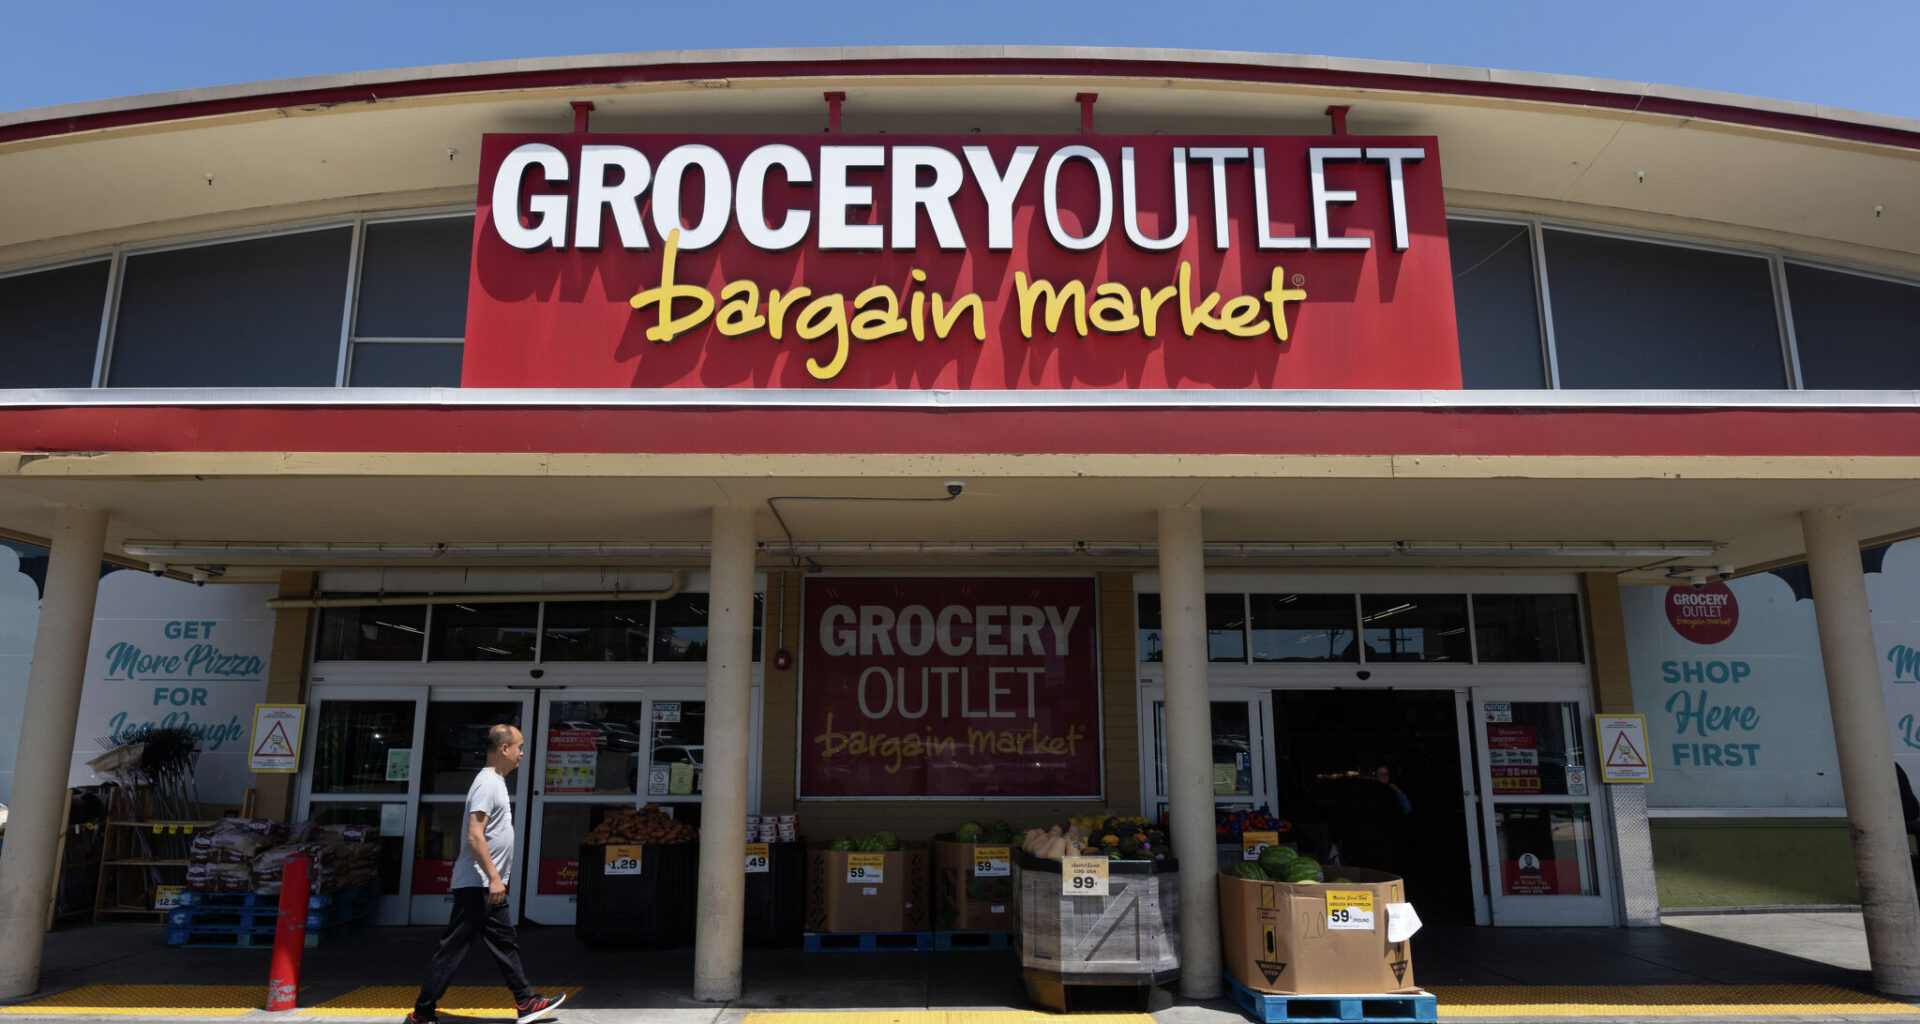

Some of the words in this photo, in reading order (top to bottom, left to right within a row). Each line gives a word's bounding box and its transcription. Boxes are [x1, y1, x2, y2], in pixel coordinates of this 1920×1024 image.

[630, 228, 986, 379] bargain
[1014, 260, 1307, 342] market
[1673, 593, 1728, 606] GROCERY
[1682, 605, 1722, 617] OUTLET
[164, 620, 216, 639] GET
[819, 604, 1081, 656] GROCERY
[105, 642, 182, 680] More
[184, 644, 265, 677] Pizza
[1661, 660, 1750, 683] SHOP
[153, 687, 208, 706] FOR
[857, 666, 1046, 719] OUTLET
[1665, 689, 1760, 737] Here
[814, 712, 957, 774] bargain
[967, 723, 1084, 757] market
[1671, 743, 1760, 767] FIRST
